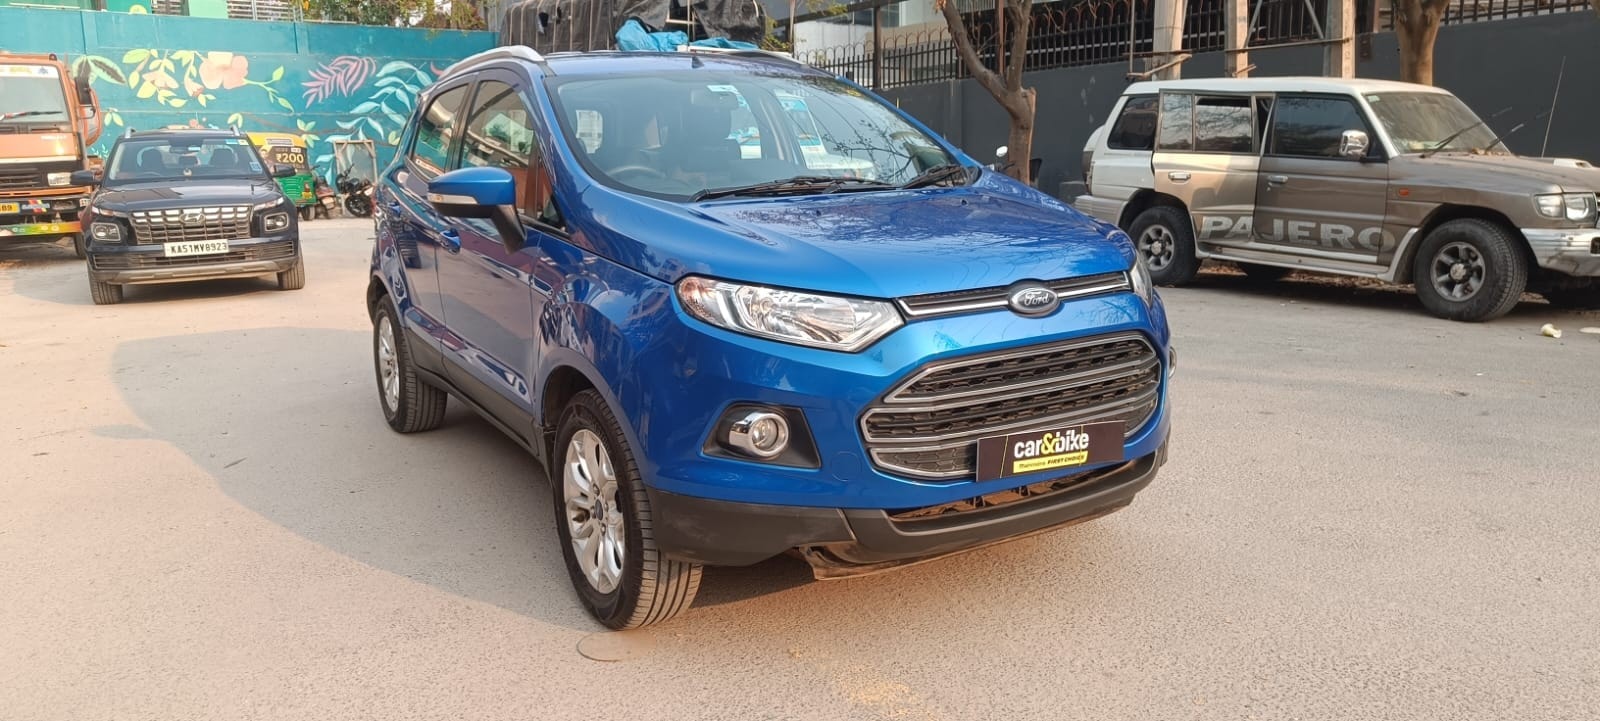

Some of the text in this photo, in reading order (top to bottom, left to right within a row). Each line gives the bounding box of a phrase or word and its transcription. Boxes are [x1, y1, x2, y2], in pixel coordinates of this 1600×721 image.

[1198, 216, 1396, 251] PAJERO
[170, 242, 227, 254] KA51MV8923
[1024, 290, 1049, 306] Ford
[1014, 429, 1089, 458] car&bike
